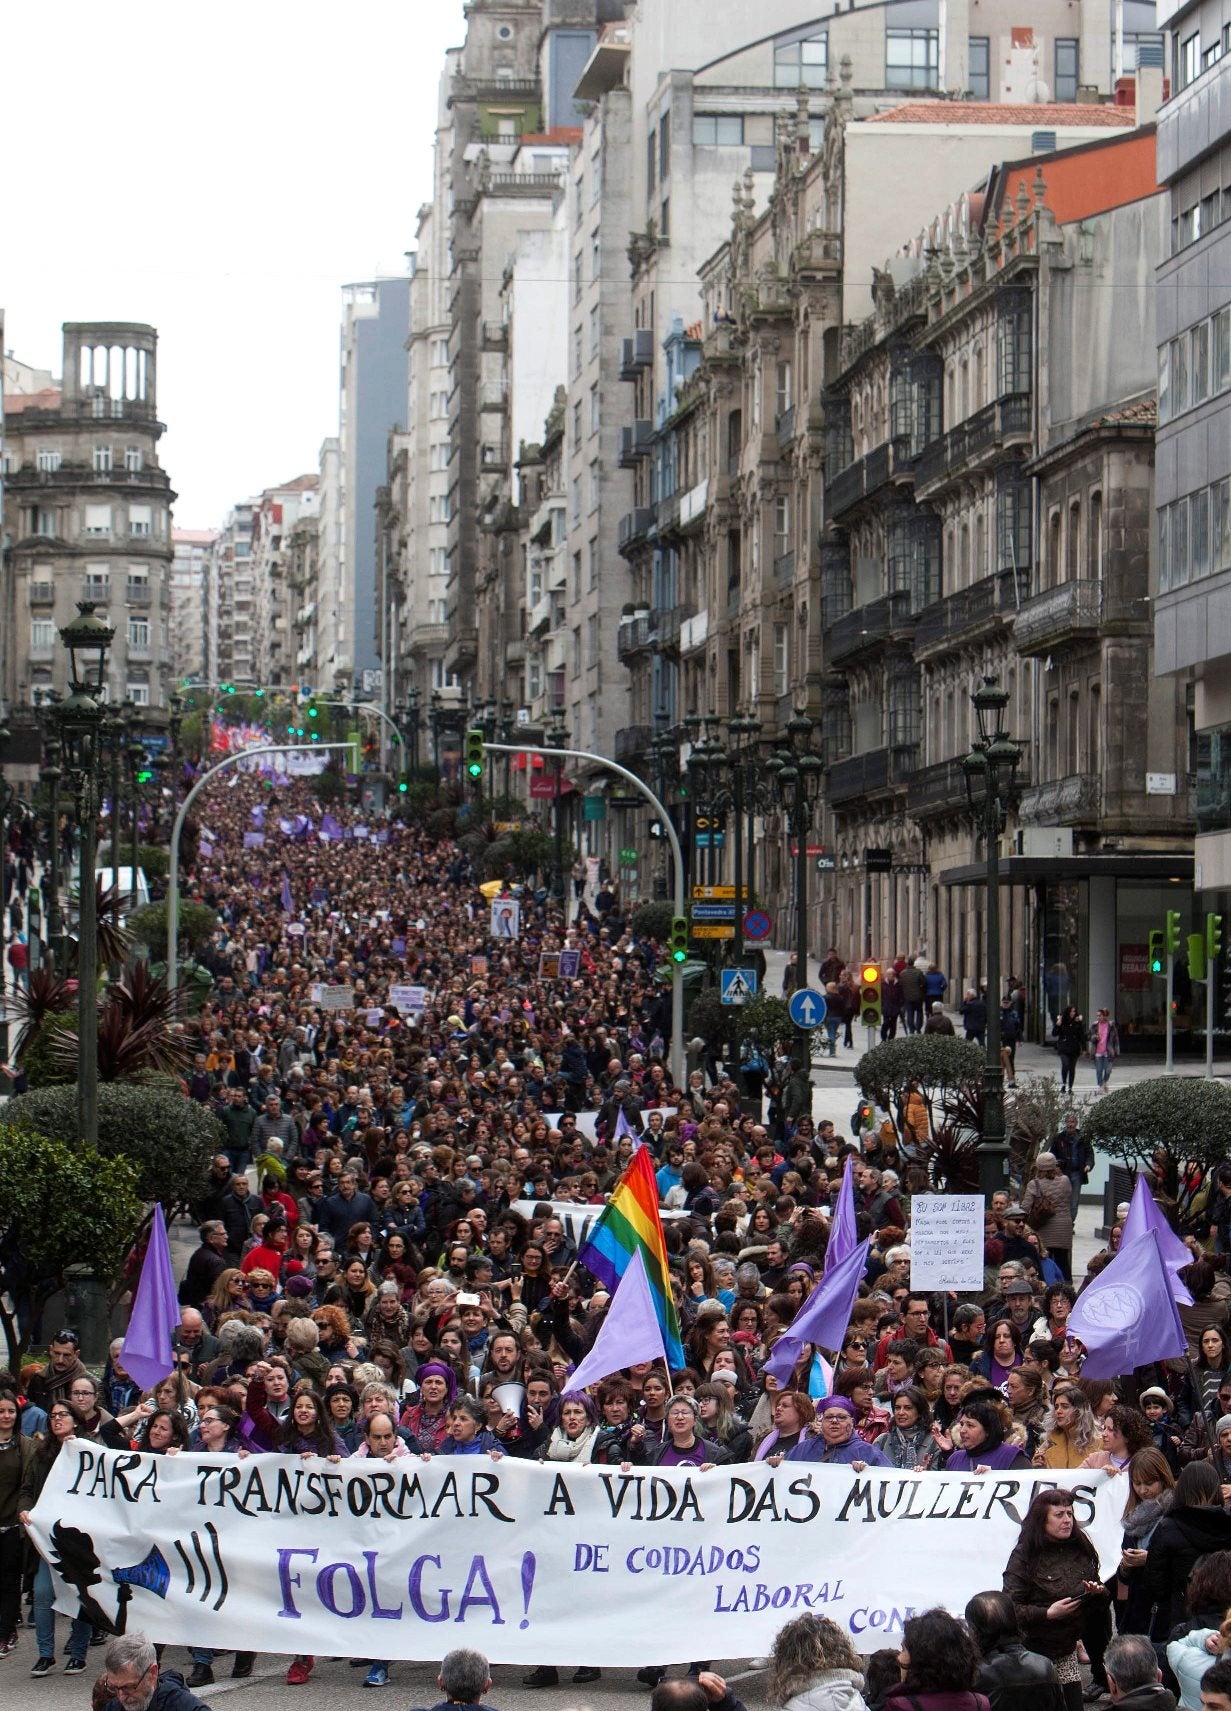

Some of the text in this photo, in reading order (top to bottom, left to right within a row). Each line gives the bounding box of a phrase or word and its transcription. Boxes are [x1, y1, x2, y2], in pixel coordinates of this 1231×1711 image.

[67, 1450, 161, 1502] PARA
[197, 1466, 515, 1522] TRANSFORMAR
[544, 1473, 575, 1515] A
[598, 1473, 705, 1521] VIDA
[726, 1473, 821, 1523] DAS
[574, 1543, 761, 1575] DE COIDADOS
[713, 1580, 845, 1613] LABORAL
